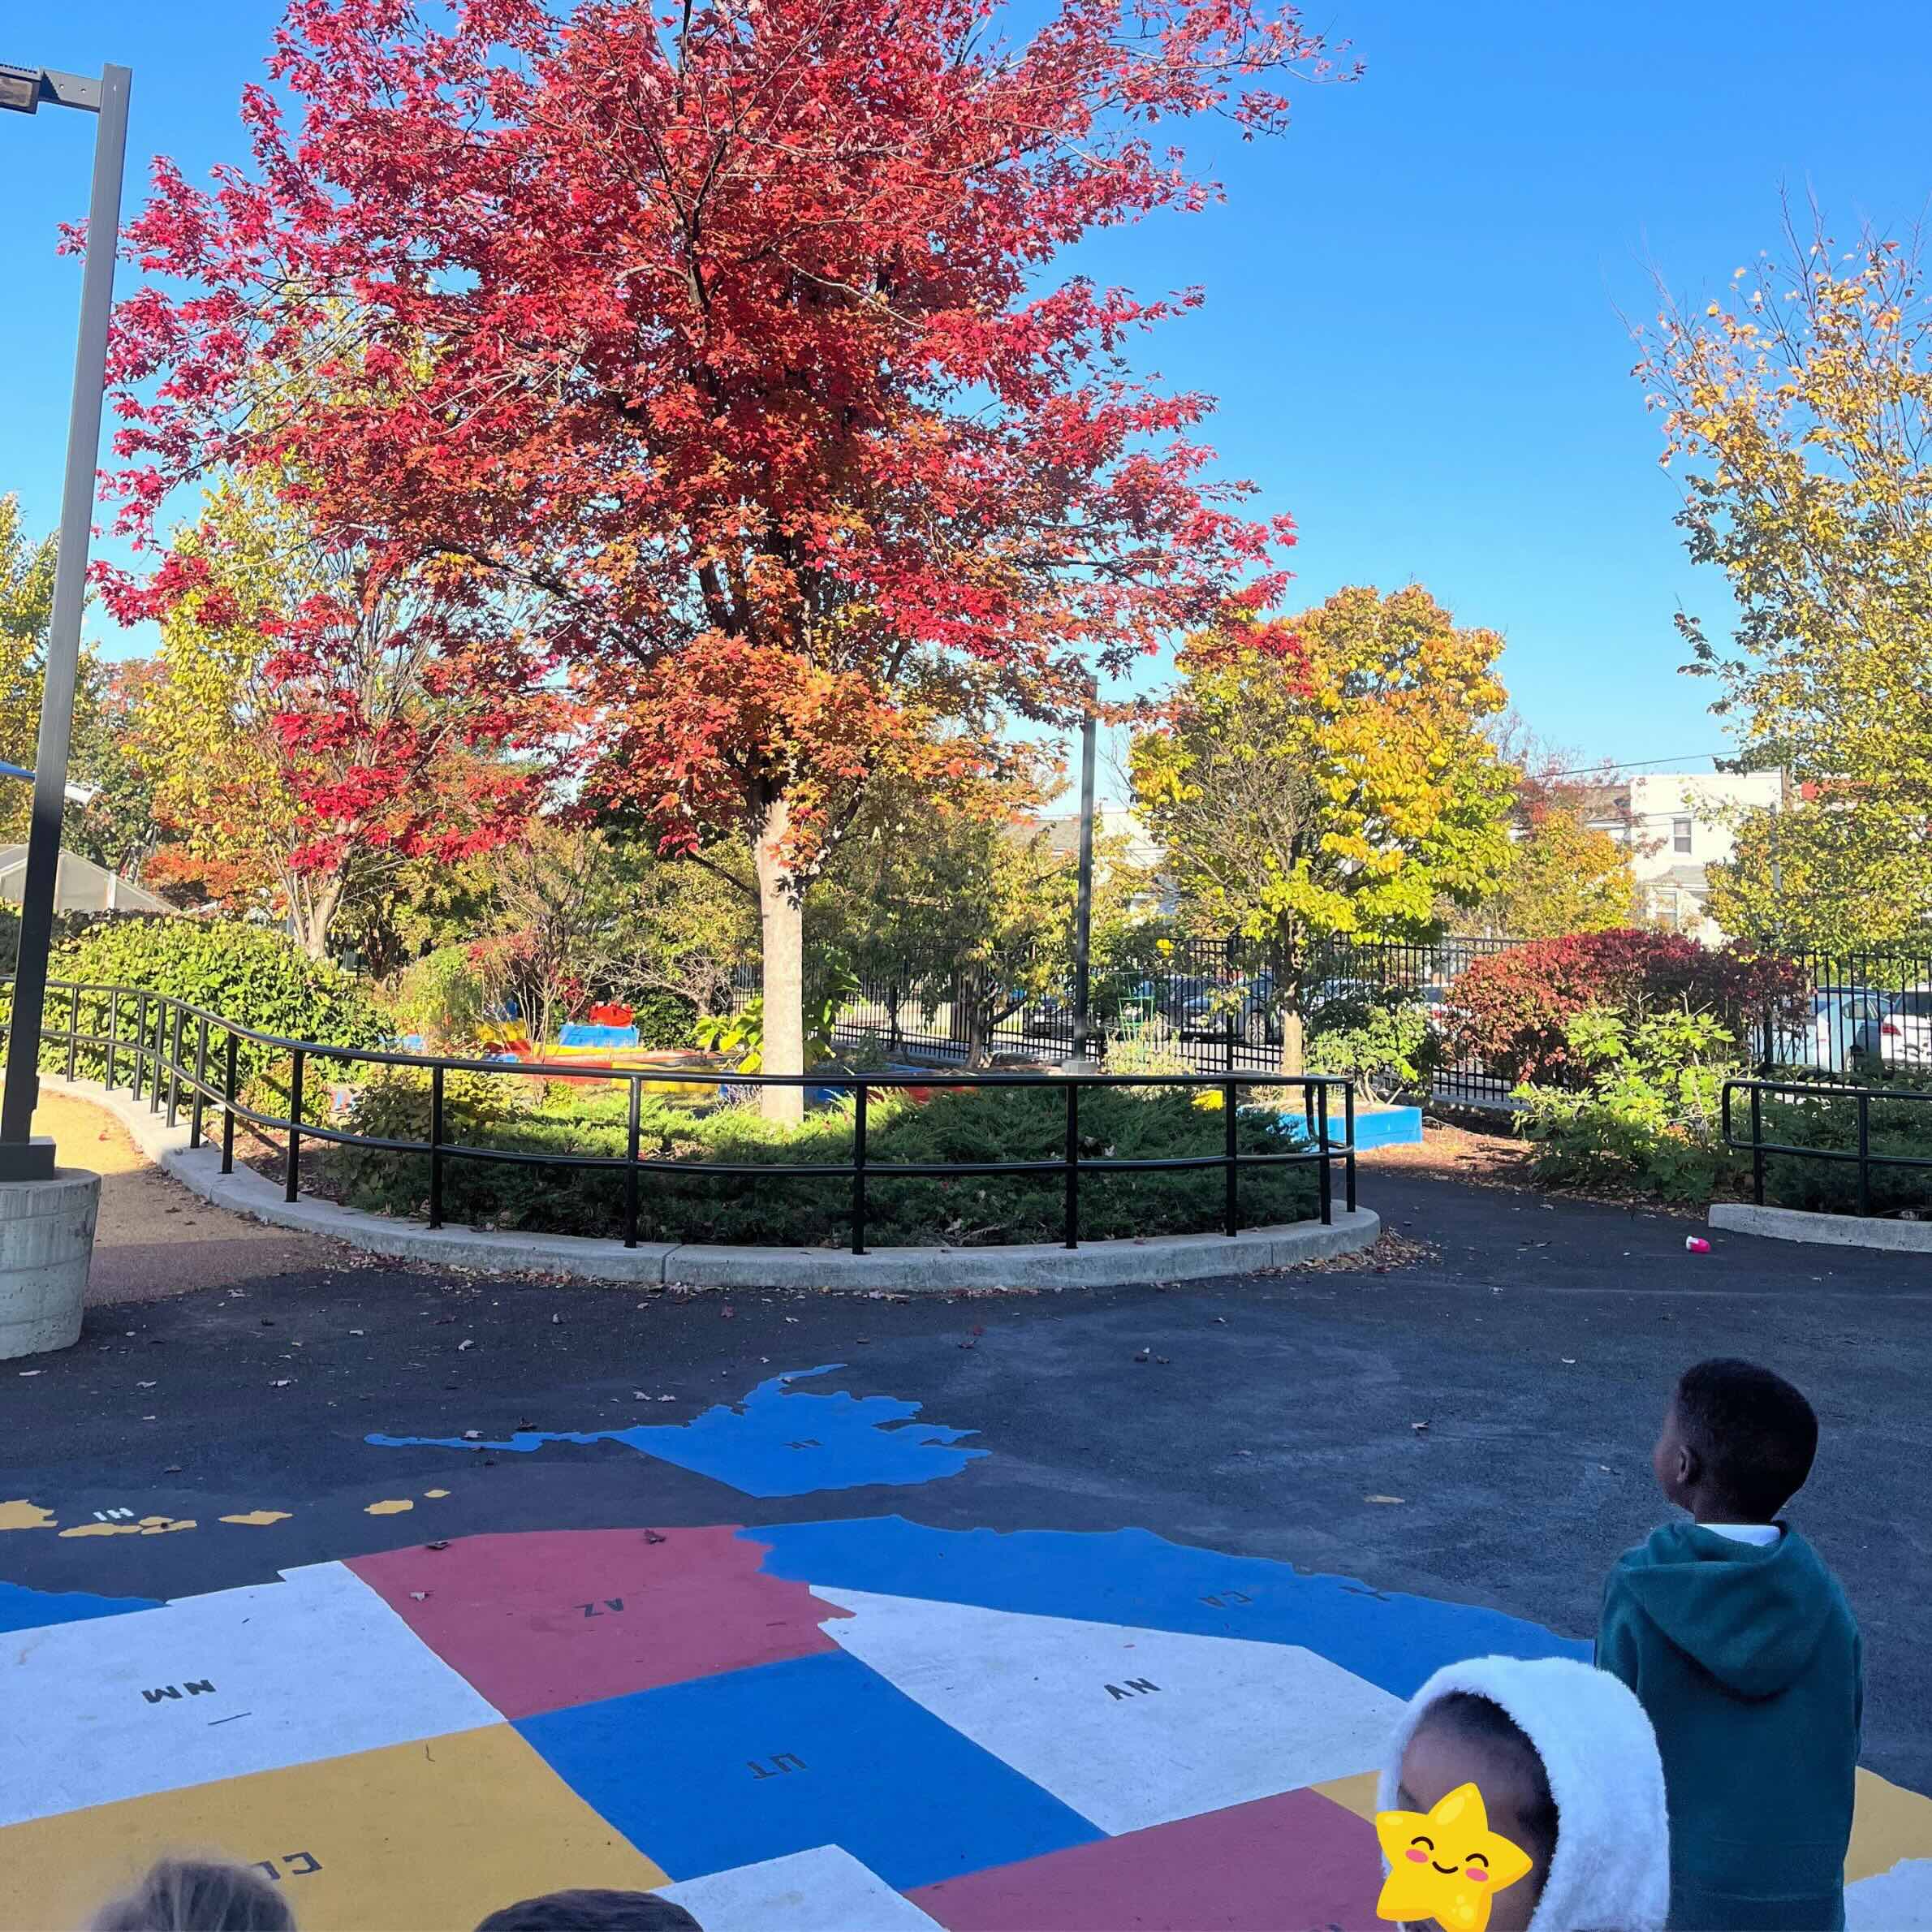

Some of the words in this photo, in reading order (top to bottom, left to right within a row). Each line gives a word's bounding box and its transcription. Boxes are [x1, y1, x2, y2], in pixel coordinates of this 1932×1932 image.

[93, 1507, 134, 1521] HI
[573, 1598, 624, 1618] AZ
[141, 1680, 216, 1704] NM
[1104, 1677, 1162, 1700] NV
[747, 1753, 807, 1779] UT
